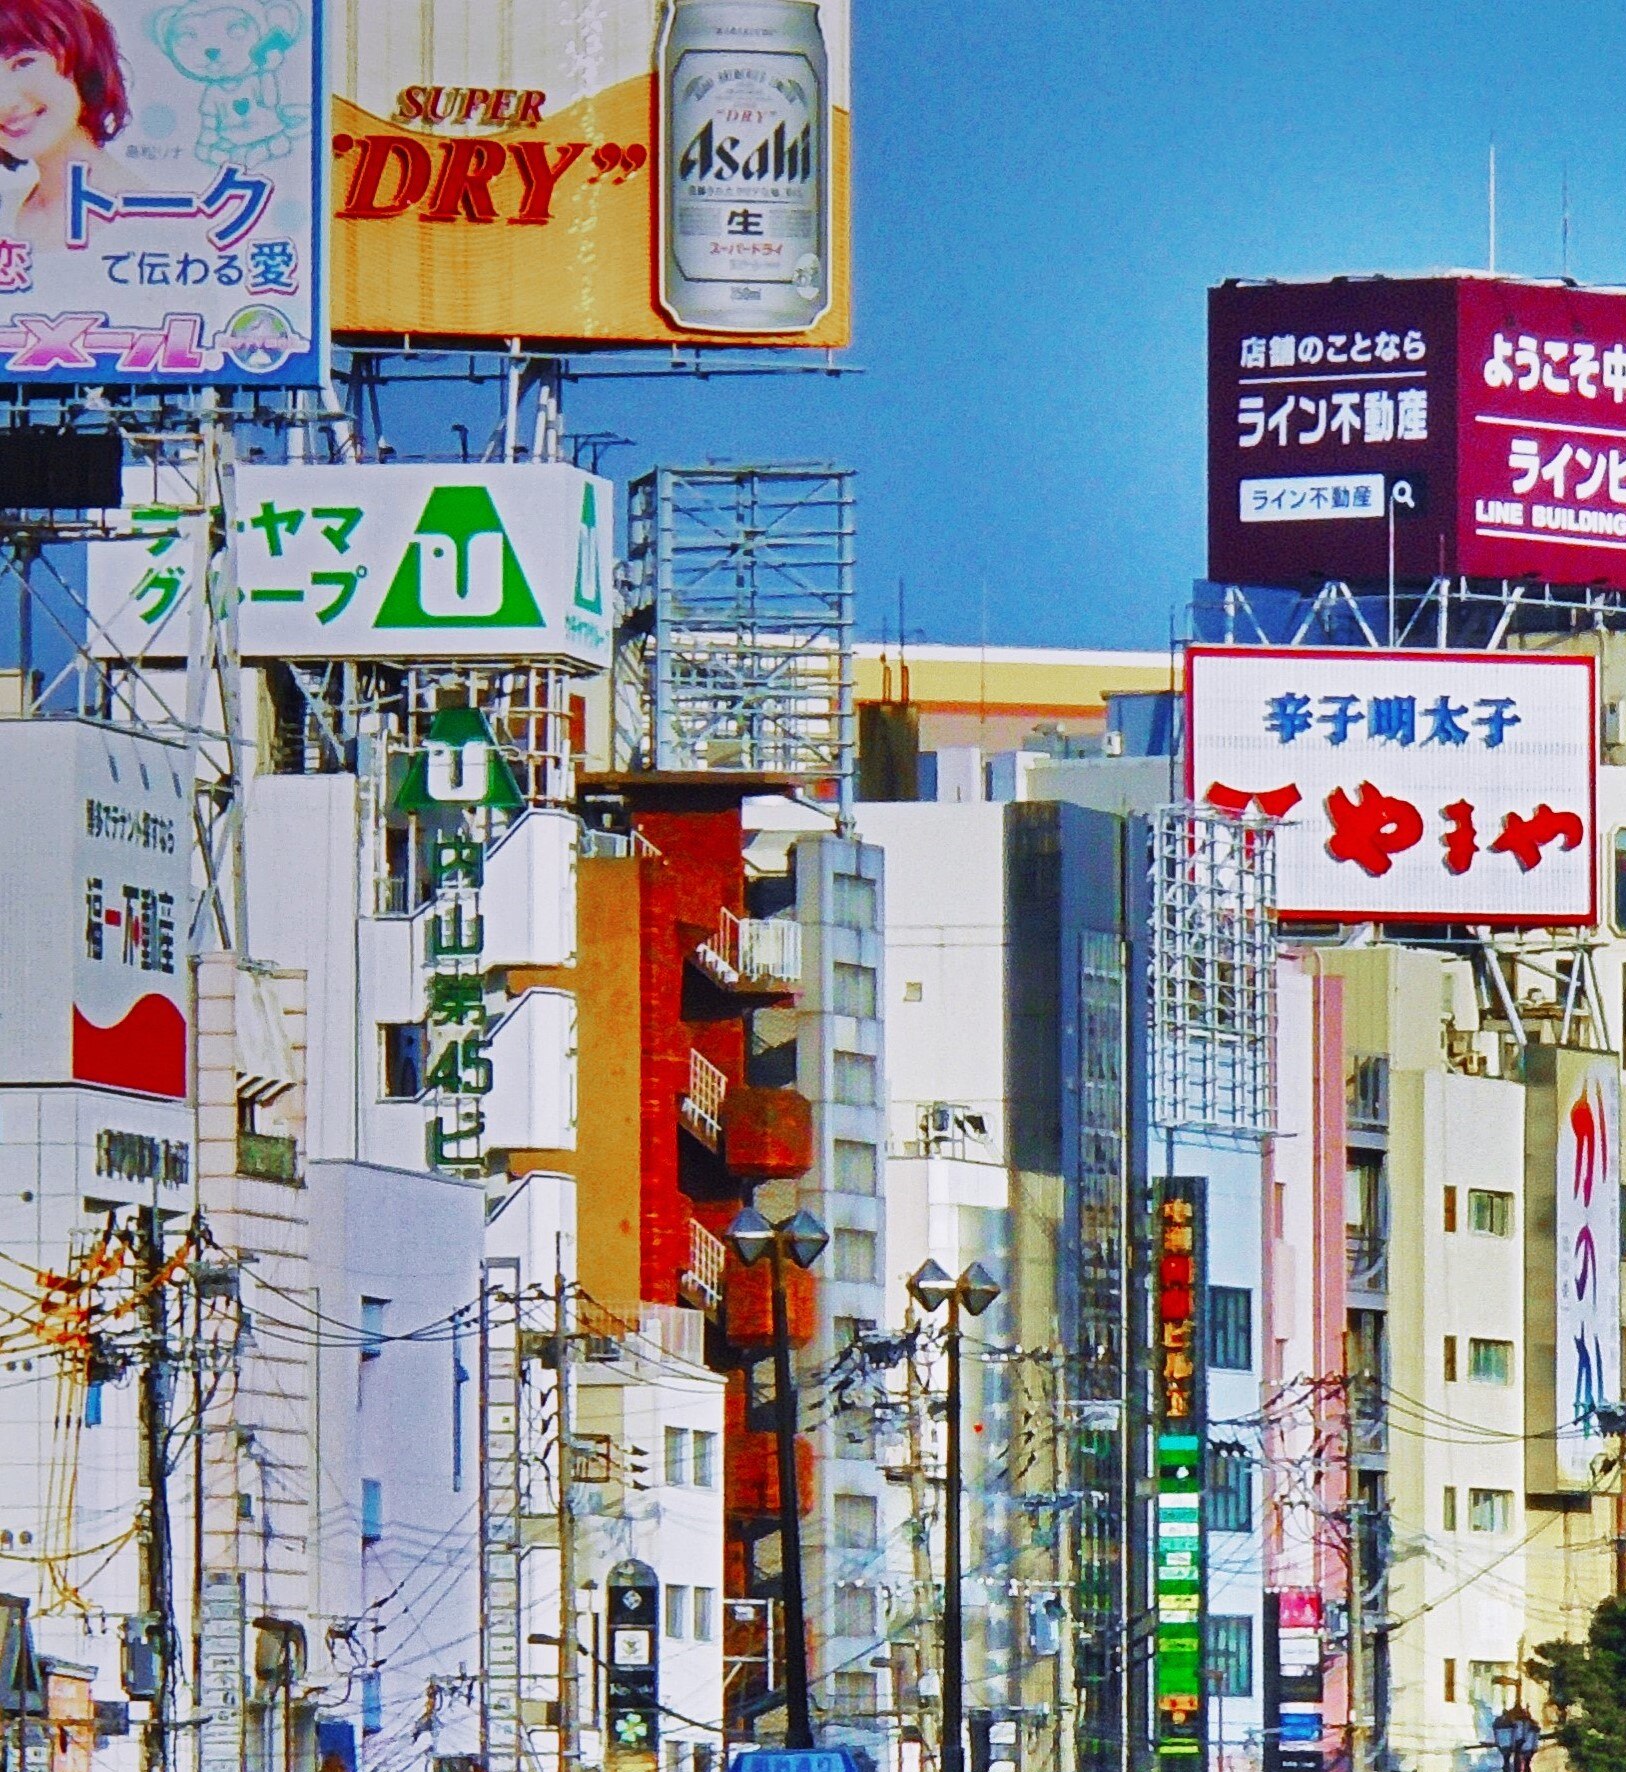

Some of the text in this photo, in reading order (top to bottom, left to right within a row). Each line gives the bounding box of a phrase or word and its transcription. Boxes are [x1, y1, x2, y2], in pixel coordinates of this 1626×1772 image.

[391, 85, 547, 128] SUPER
[680, 119, 811, 183] Asahi
[67, 162, 273, 249] トーク
[727, 208, 763, 236] 生
[102, 239, 298, 295] で伝わる愛
[1240, 329, 1426, 368] 店舗のことなら
[1238, 388, 1428, 447] ライン不動産
[1252, 485, 1372, 511] ライン不動産
[1475, 499, 1524, 526] LINE
[1262, 691, 1522, 750] 辛子明太子
